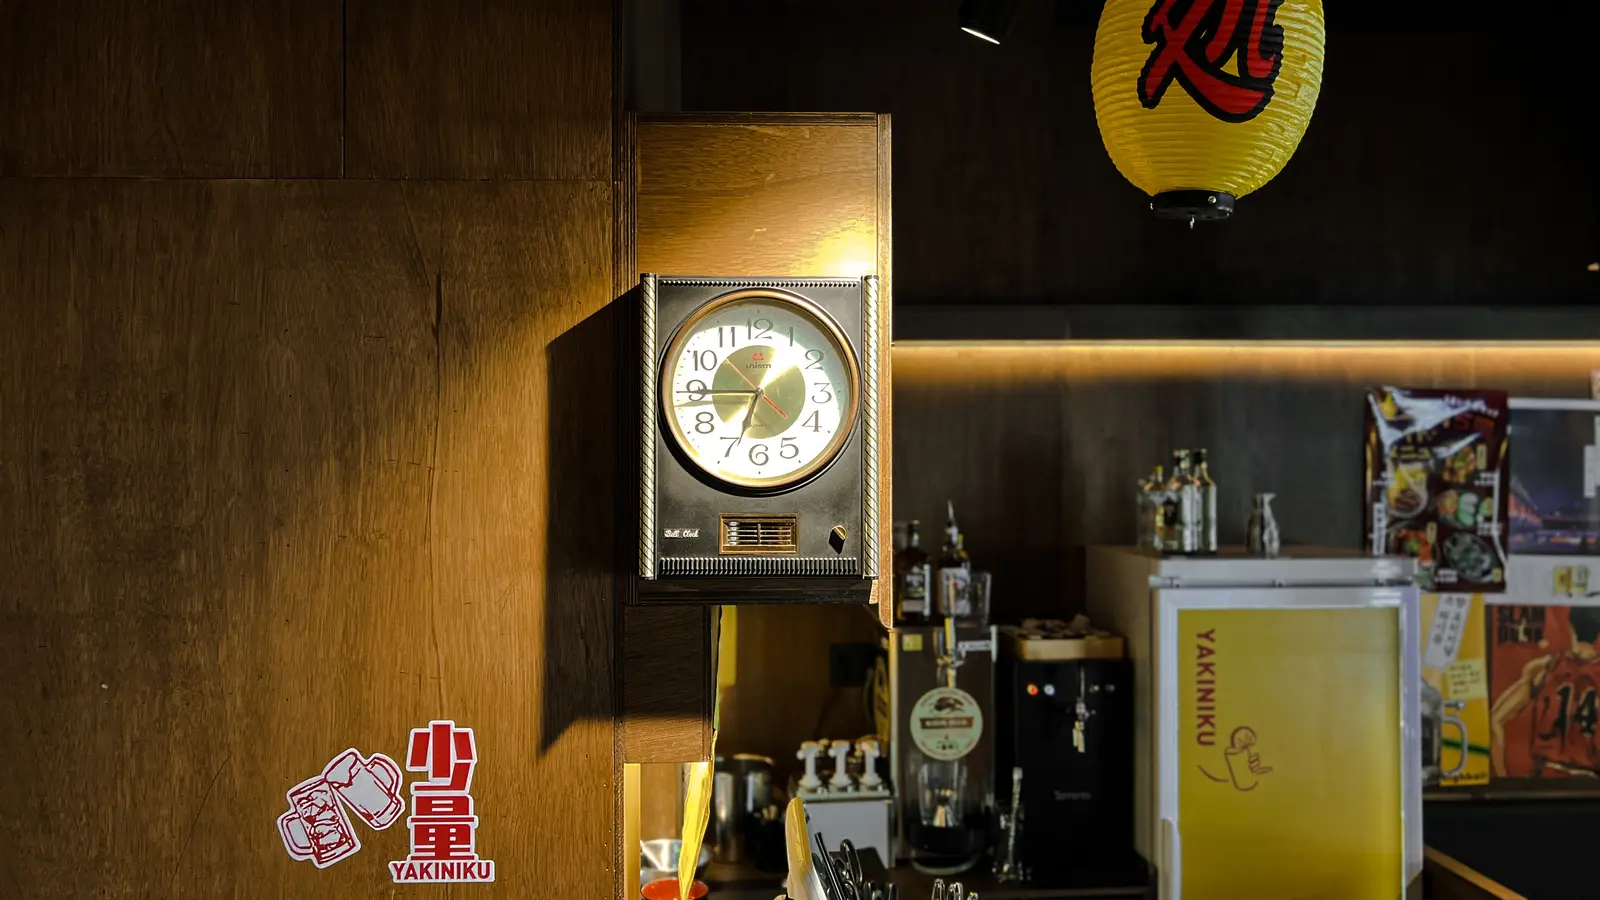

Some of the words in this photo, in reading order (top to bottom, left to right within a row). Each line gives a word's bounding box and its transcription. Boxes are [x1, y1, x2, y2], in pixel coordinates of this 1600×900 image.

[718, 326, 736, 348] 11
[746, 317, 774, 340] 12
[788, 326, 794, 347] 1
[692, 350, 718, 371] 10
[804, 349, 825, 370] 2
[686, 379, 708, 402] 9
[811, 382, 833, 404] 3
[694, 411, 715, 435] 8
[801, 410, 823, 433] 4
[719, 436, 740, 458] 7
[748, 444, 769, 466] 6
[779, 436, 799, 459] 5
[682, 529, 700, 538] Clock
[1195, 628, 1216, 747] YAKINIKU
[1555, 684, 1598, 742] 14
[392, 862, 491, 880] YAKINIKU
